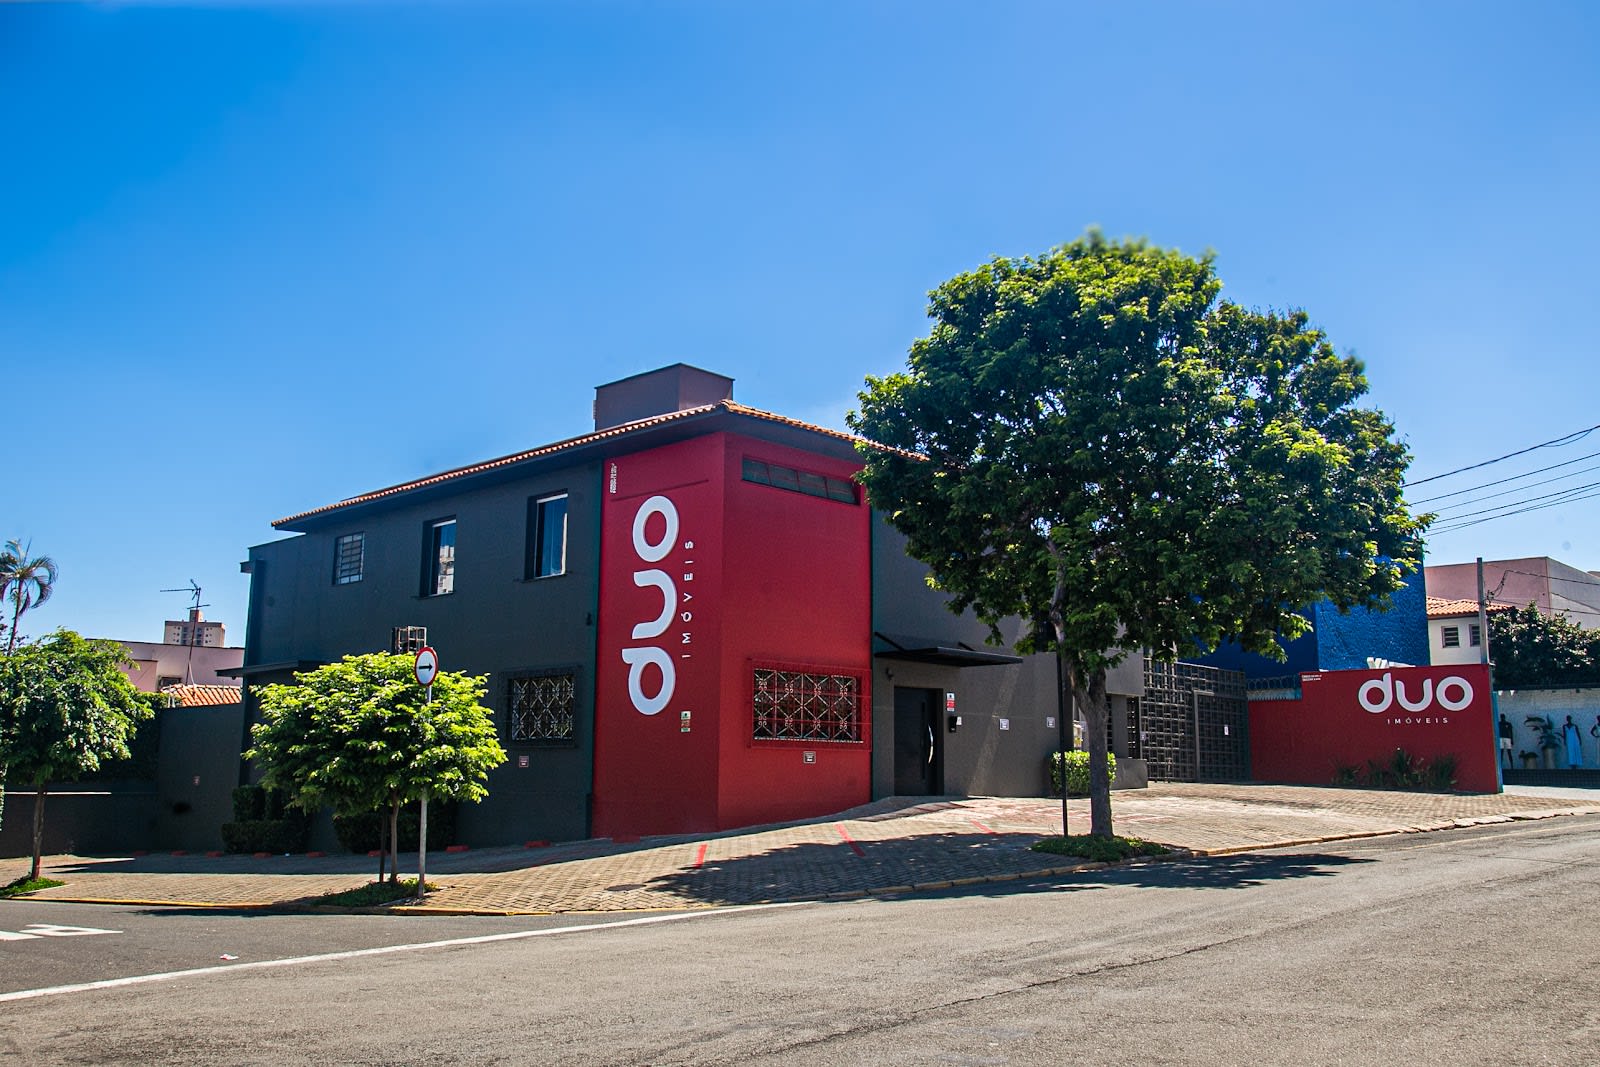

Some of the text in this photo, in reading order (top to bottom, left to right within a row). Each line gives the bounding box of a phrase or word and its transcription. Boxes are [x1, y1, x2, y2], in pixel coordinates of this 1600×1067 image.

[622, 495, 680, 715] duo
[681, 540, 694, 658] IMÓVEIS
[1358, 672, 1474, 714] duo
[1387, 717, 1449, 725] IMÓVEIS
